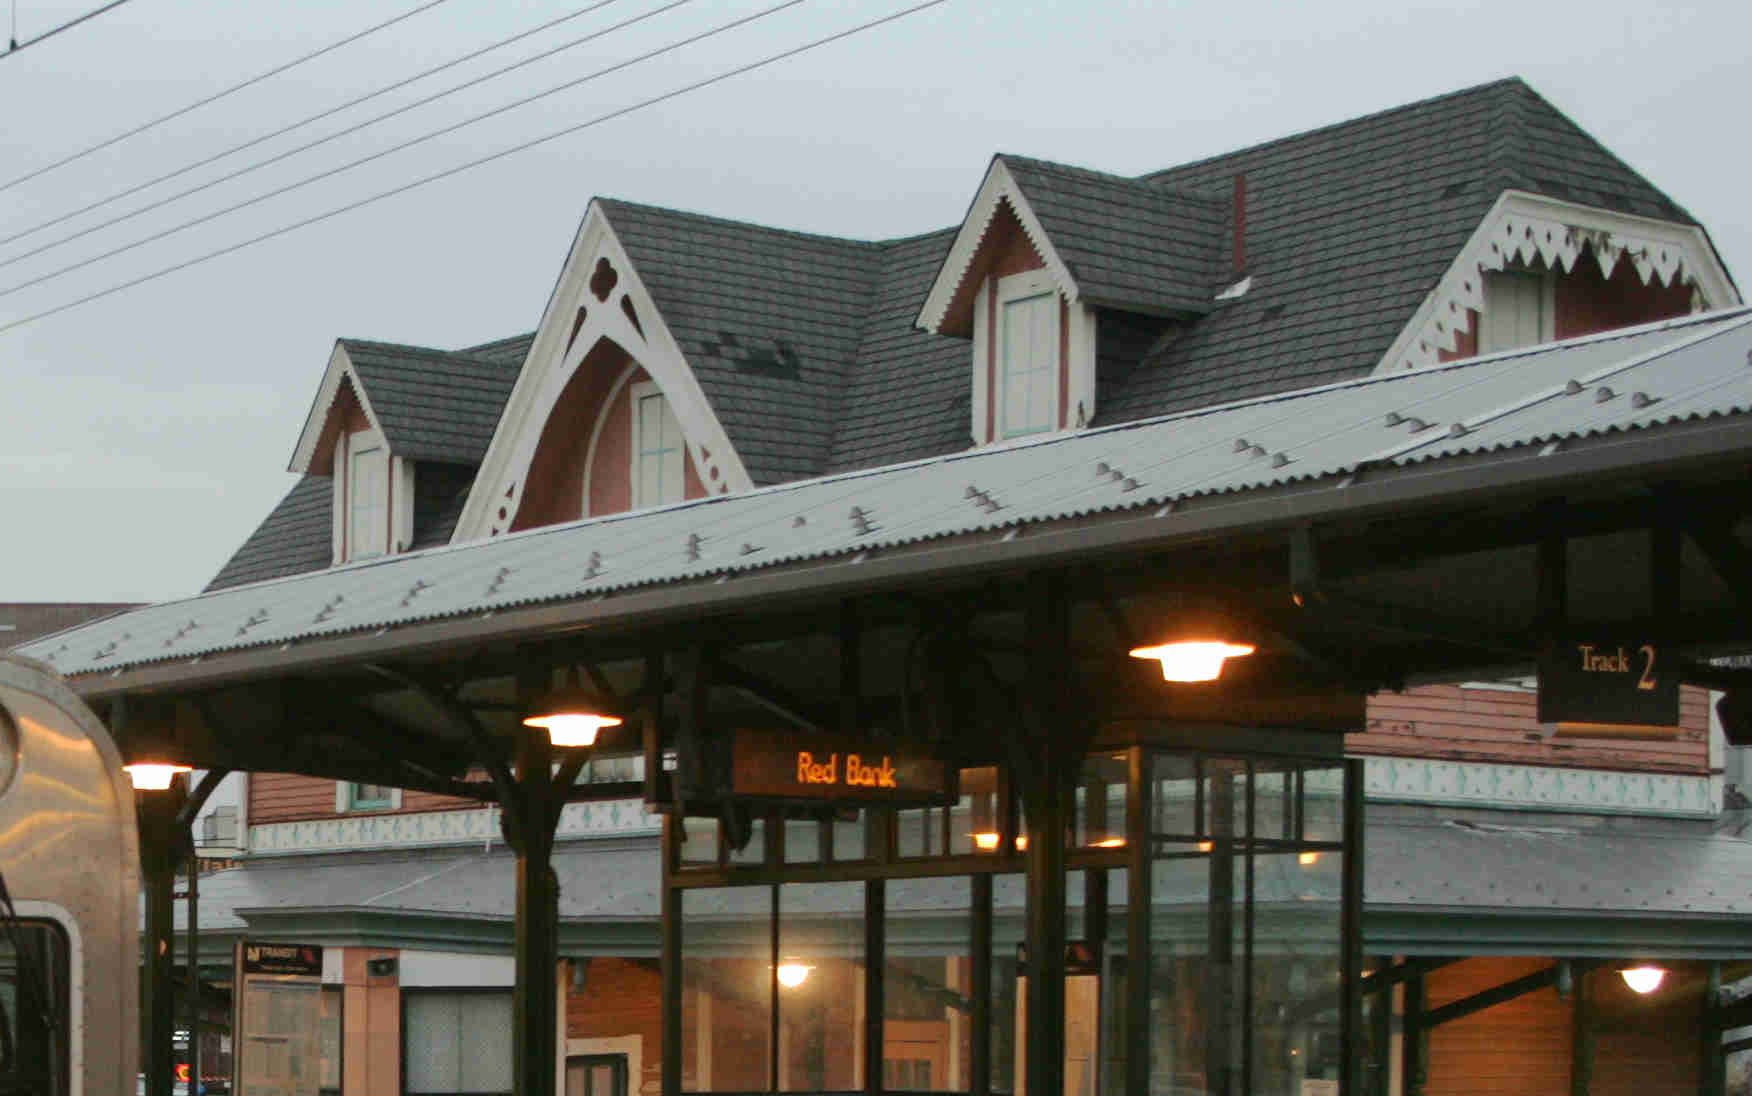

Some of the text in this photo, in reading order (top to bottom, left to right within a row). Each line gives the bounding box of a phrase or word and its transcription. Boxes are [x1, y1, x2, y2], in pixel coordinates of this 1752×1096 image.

[1578, 644, 1657, 690] Track 2
[797, 752, 897, 788] Red Bank
